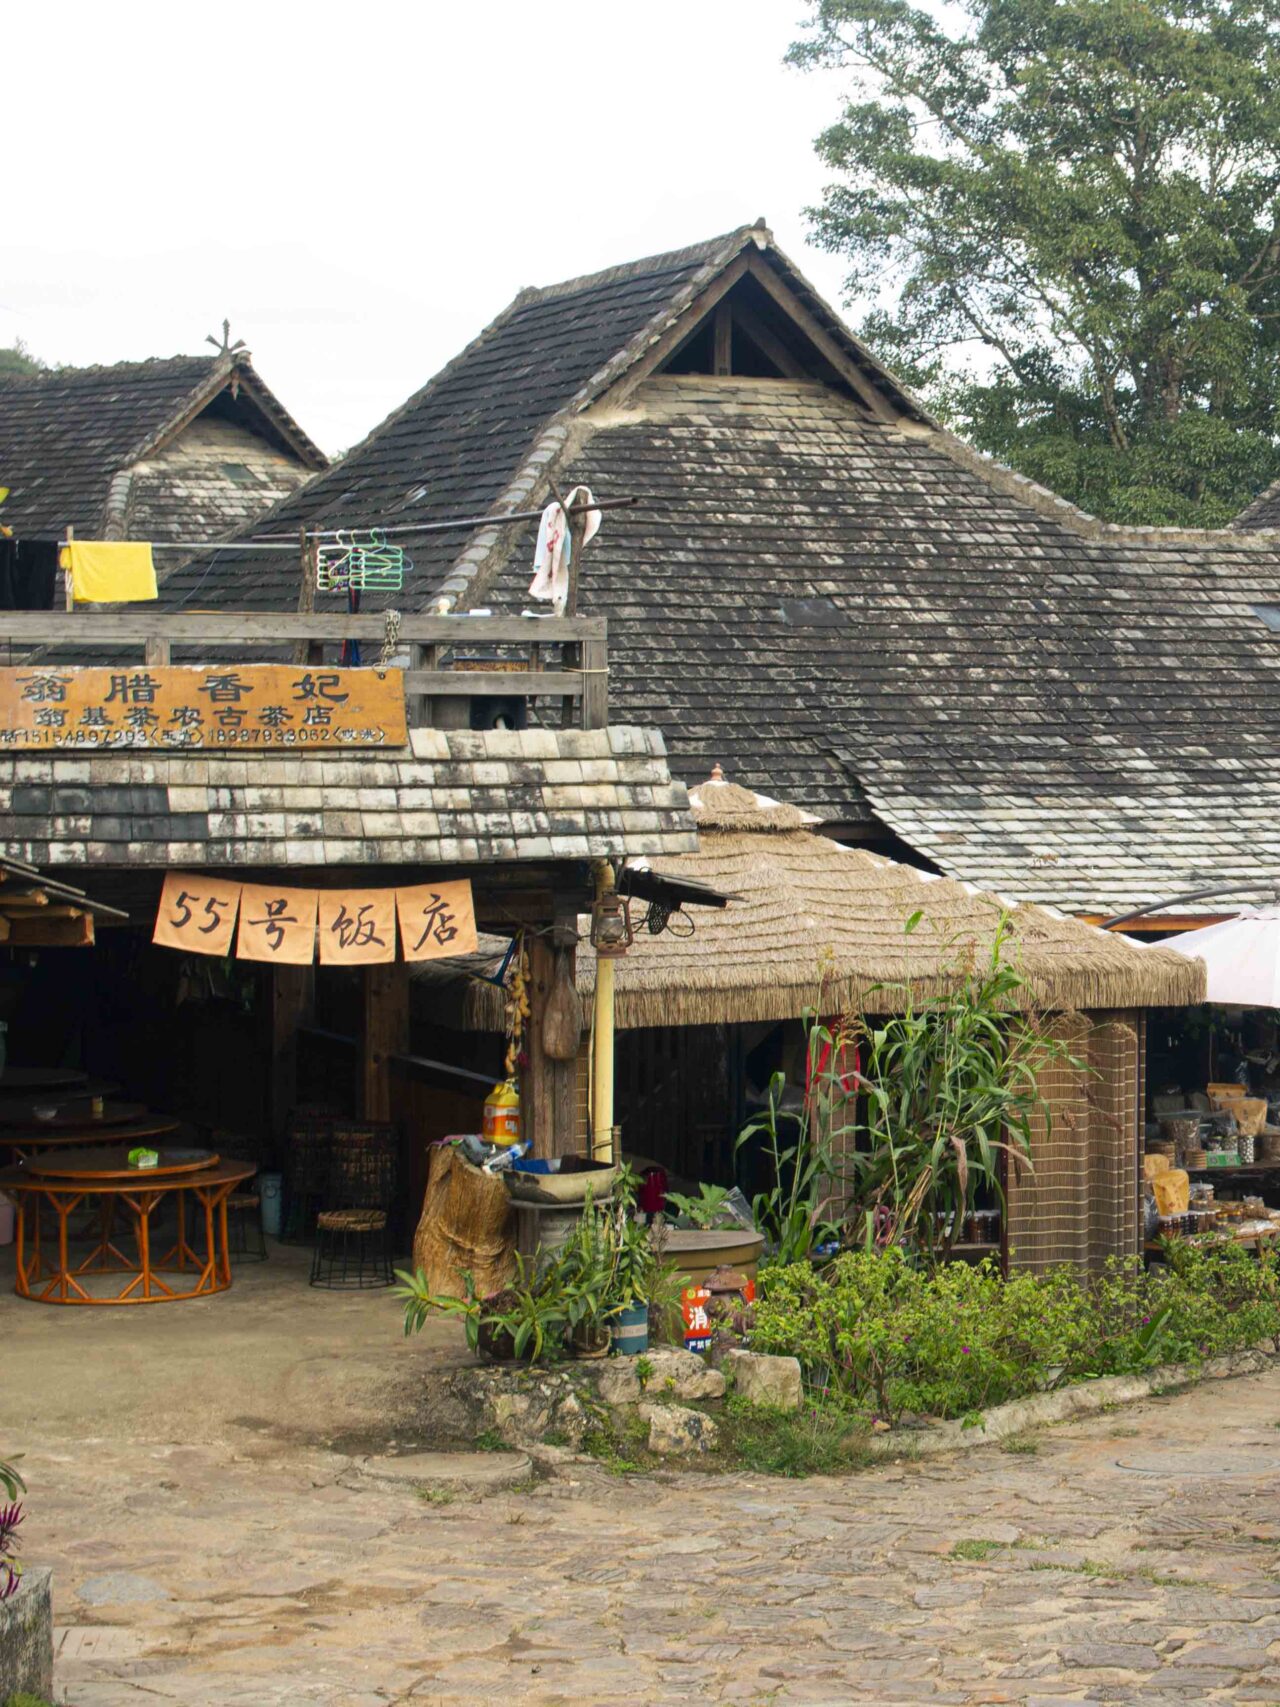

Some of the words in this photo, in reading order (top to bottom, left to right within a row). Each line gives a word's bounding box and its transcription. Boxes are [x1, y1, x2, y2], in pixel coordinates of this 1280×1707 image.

[16, 671, 349, 704] 翁腊香妃
[33, 706, 334, 728] 翁基茶农古茶店
[169, 891, 459, 952] 55号饭店
